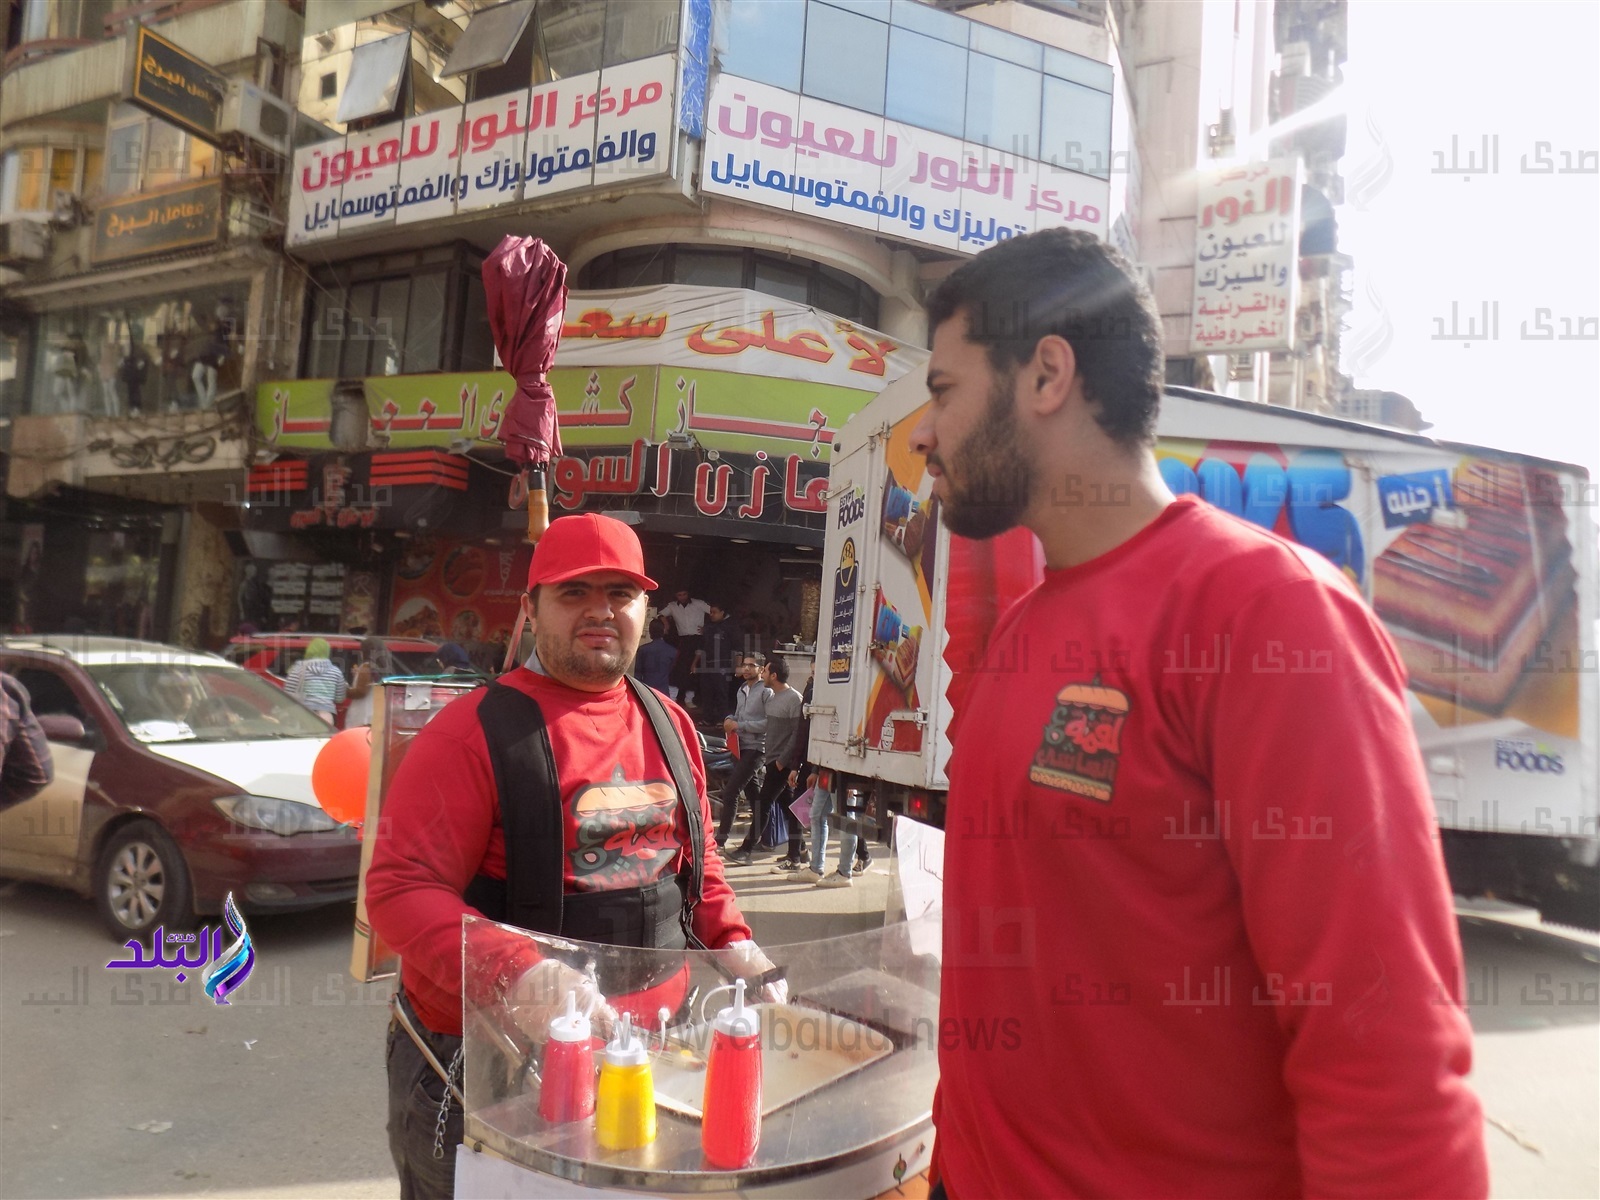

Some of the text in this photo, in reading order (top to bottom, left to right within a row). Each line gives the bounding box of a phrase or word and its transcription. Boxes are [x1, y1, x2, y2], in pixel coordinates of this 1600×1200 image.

[301, 81, 663, 194] مركز النور للعيون
[718, 93, 1101, 224] مركز النور للعيون
[304, 129, 657, 232] والفمتوليزك والفمتوسمايل
[711, 153, 1029, 247] توليزك والفمتوسمايل
[1198, 176, 1292, 229] النور
[106, 208, 159, 238] البرج
[1198, 221, 1288, 261] للعيون
[1198, 263, 1288, 291] والليزك
[561, 309, 668, 339] سع
[837, 494, 866, 530] FOODS
[1495, 750, 1565, 775] FOODS
